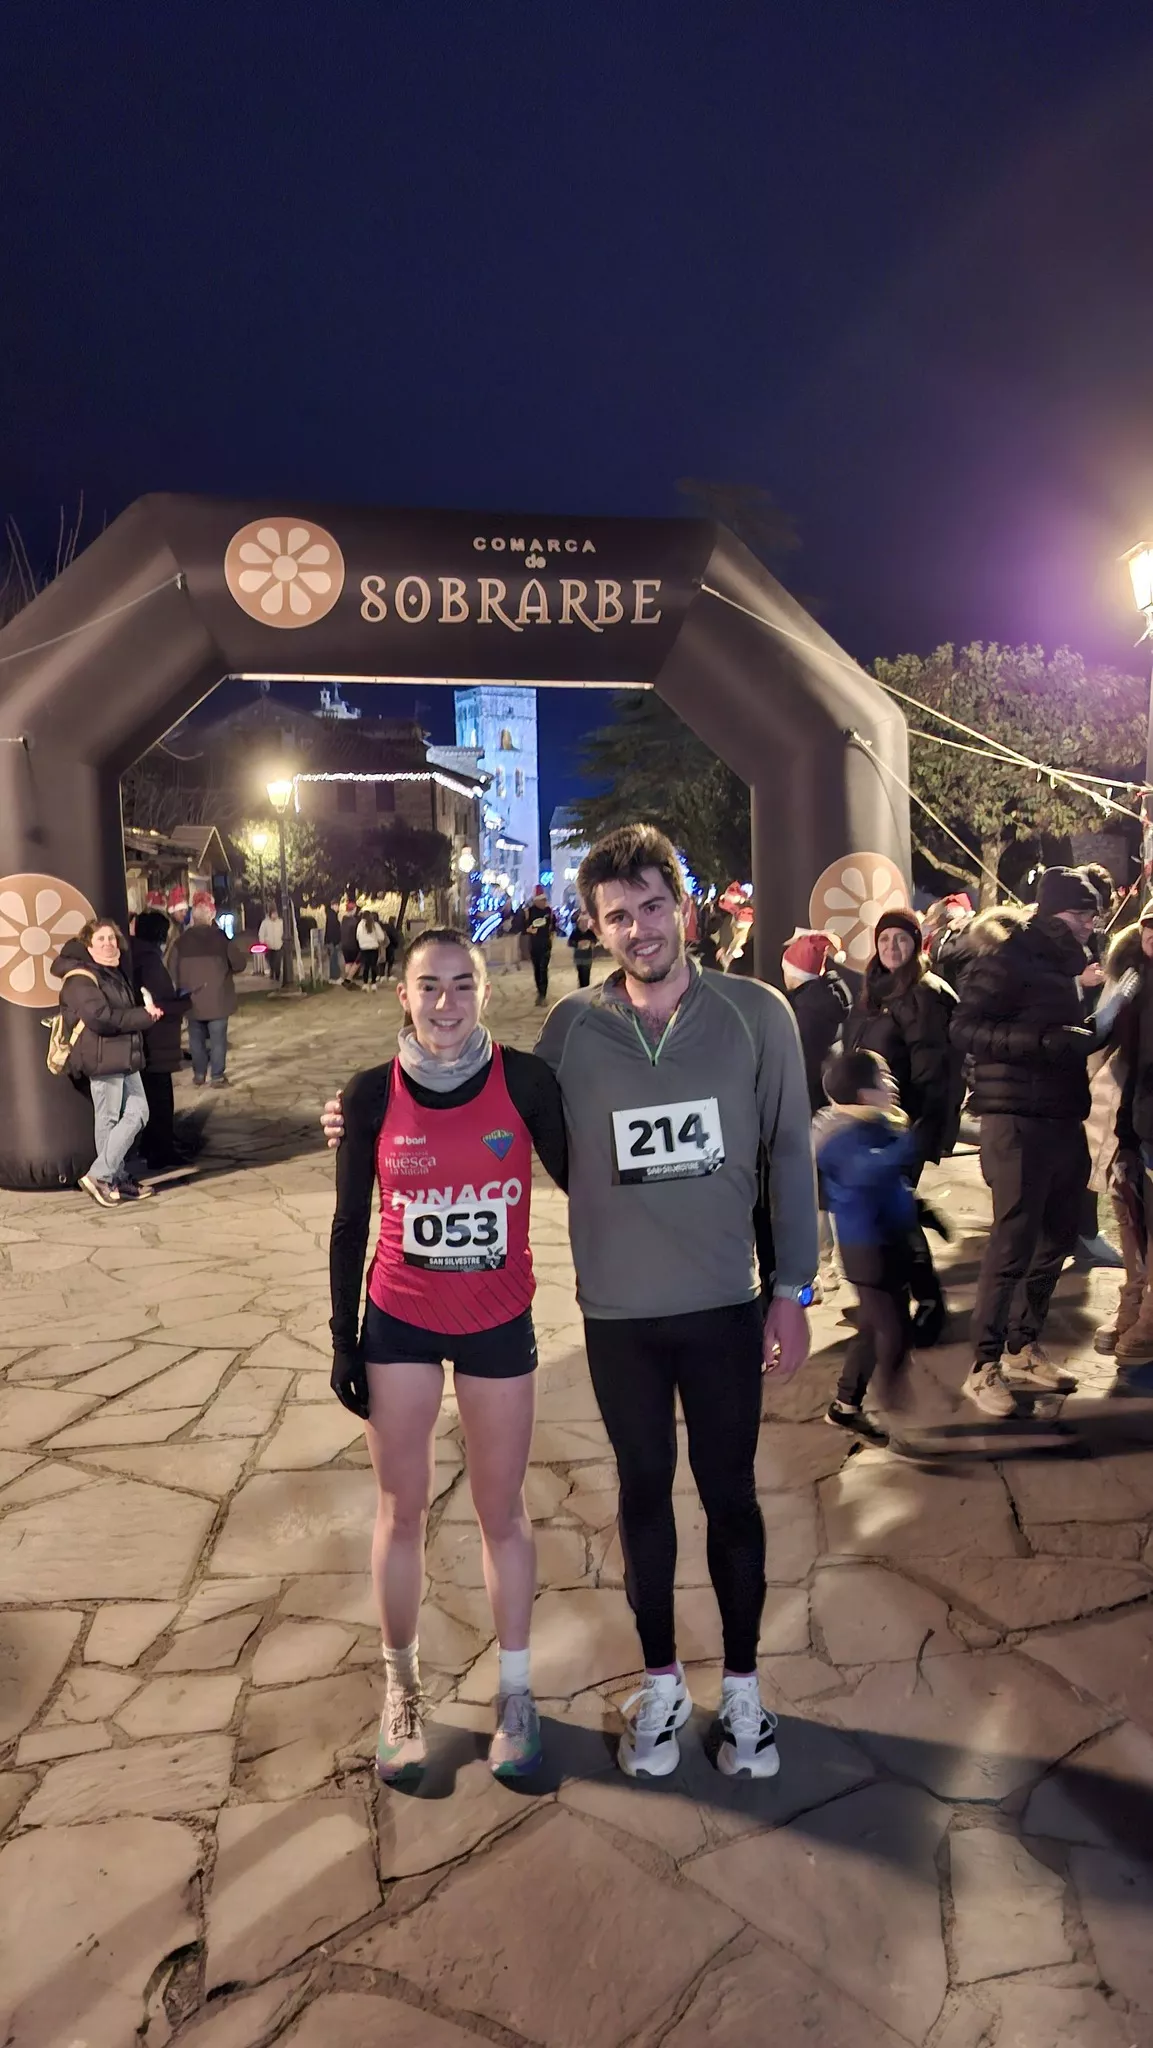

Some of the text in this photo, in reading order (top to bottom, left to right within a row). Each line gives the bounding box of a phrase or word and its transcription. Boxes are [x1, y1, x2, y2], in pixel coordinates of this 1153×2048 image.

[473, 536, 597, 553] COMARCA
[525, 553, 547, 569] de
[360, 575, 662, 633] SOBRARBE
[628, 1112, 711, 1157] 214
[412, 1210, 499, 1248] 053
[429, 1256, 481, 1266] SAN SILVESTRE
